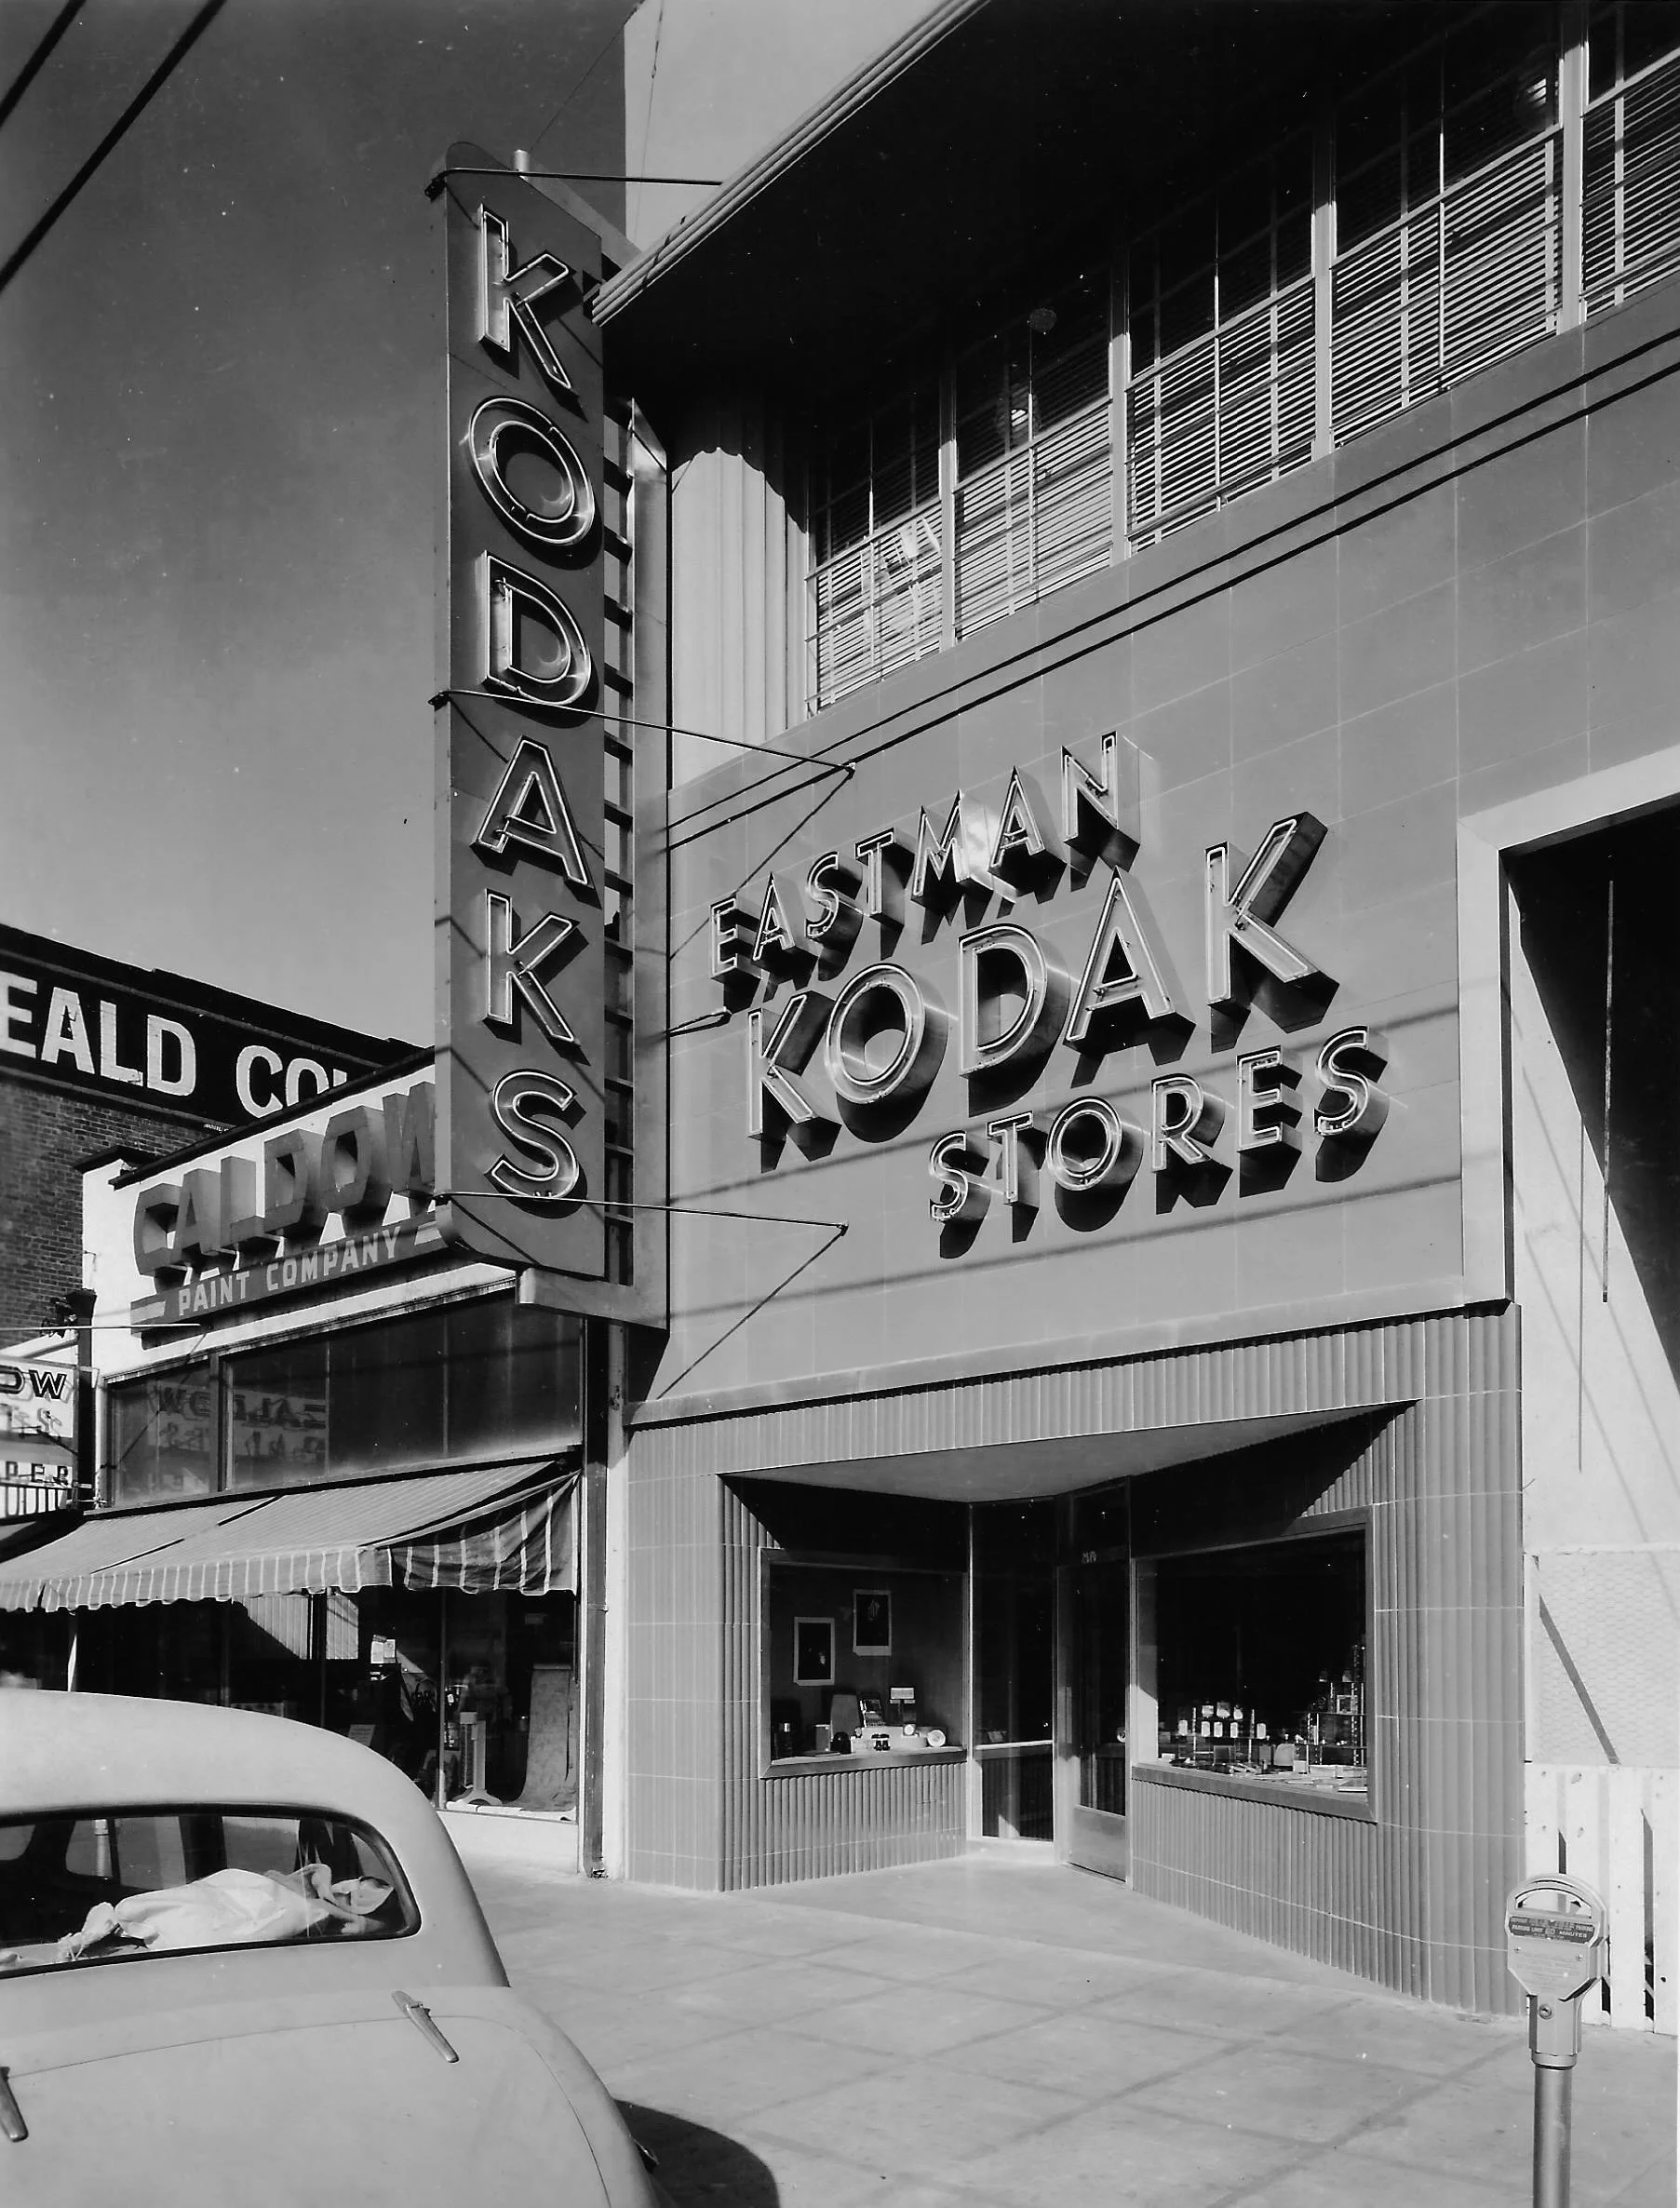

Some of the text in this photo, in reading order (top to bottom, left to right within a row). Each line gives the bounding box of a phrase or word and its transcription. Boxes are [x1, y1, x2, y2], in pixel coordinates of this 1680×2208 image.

[466, 203, 596, 1203] KODAKS
[709, 731, 1124, 982] EASTMAN
[0, 970, 196, 1097] EALD
[747, 812, 1326, 1143] KODAK
[929, 1025, 1378, 1224] STORES
[178, 1225, 402, 1317] PAINT COMPANY
